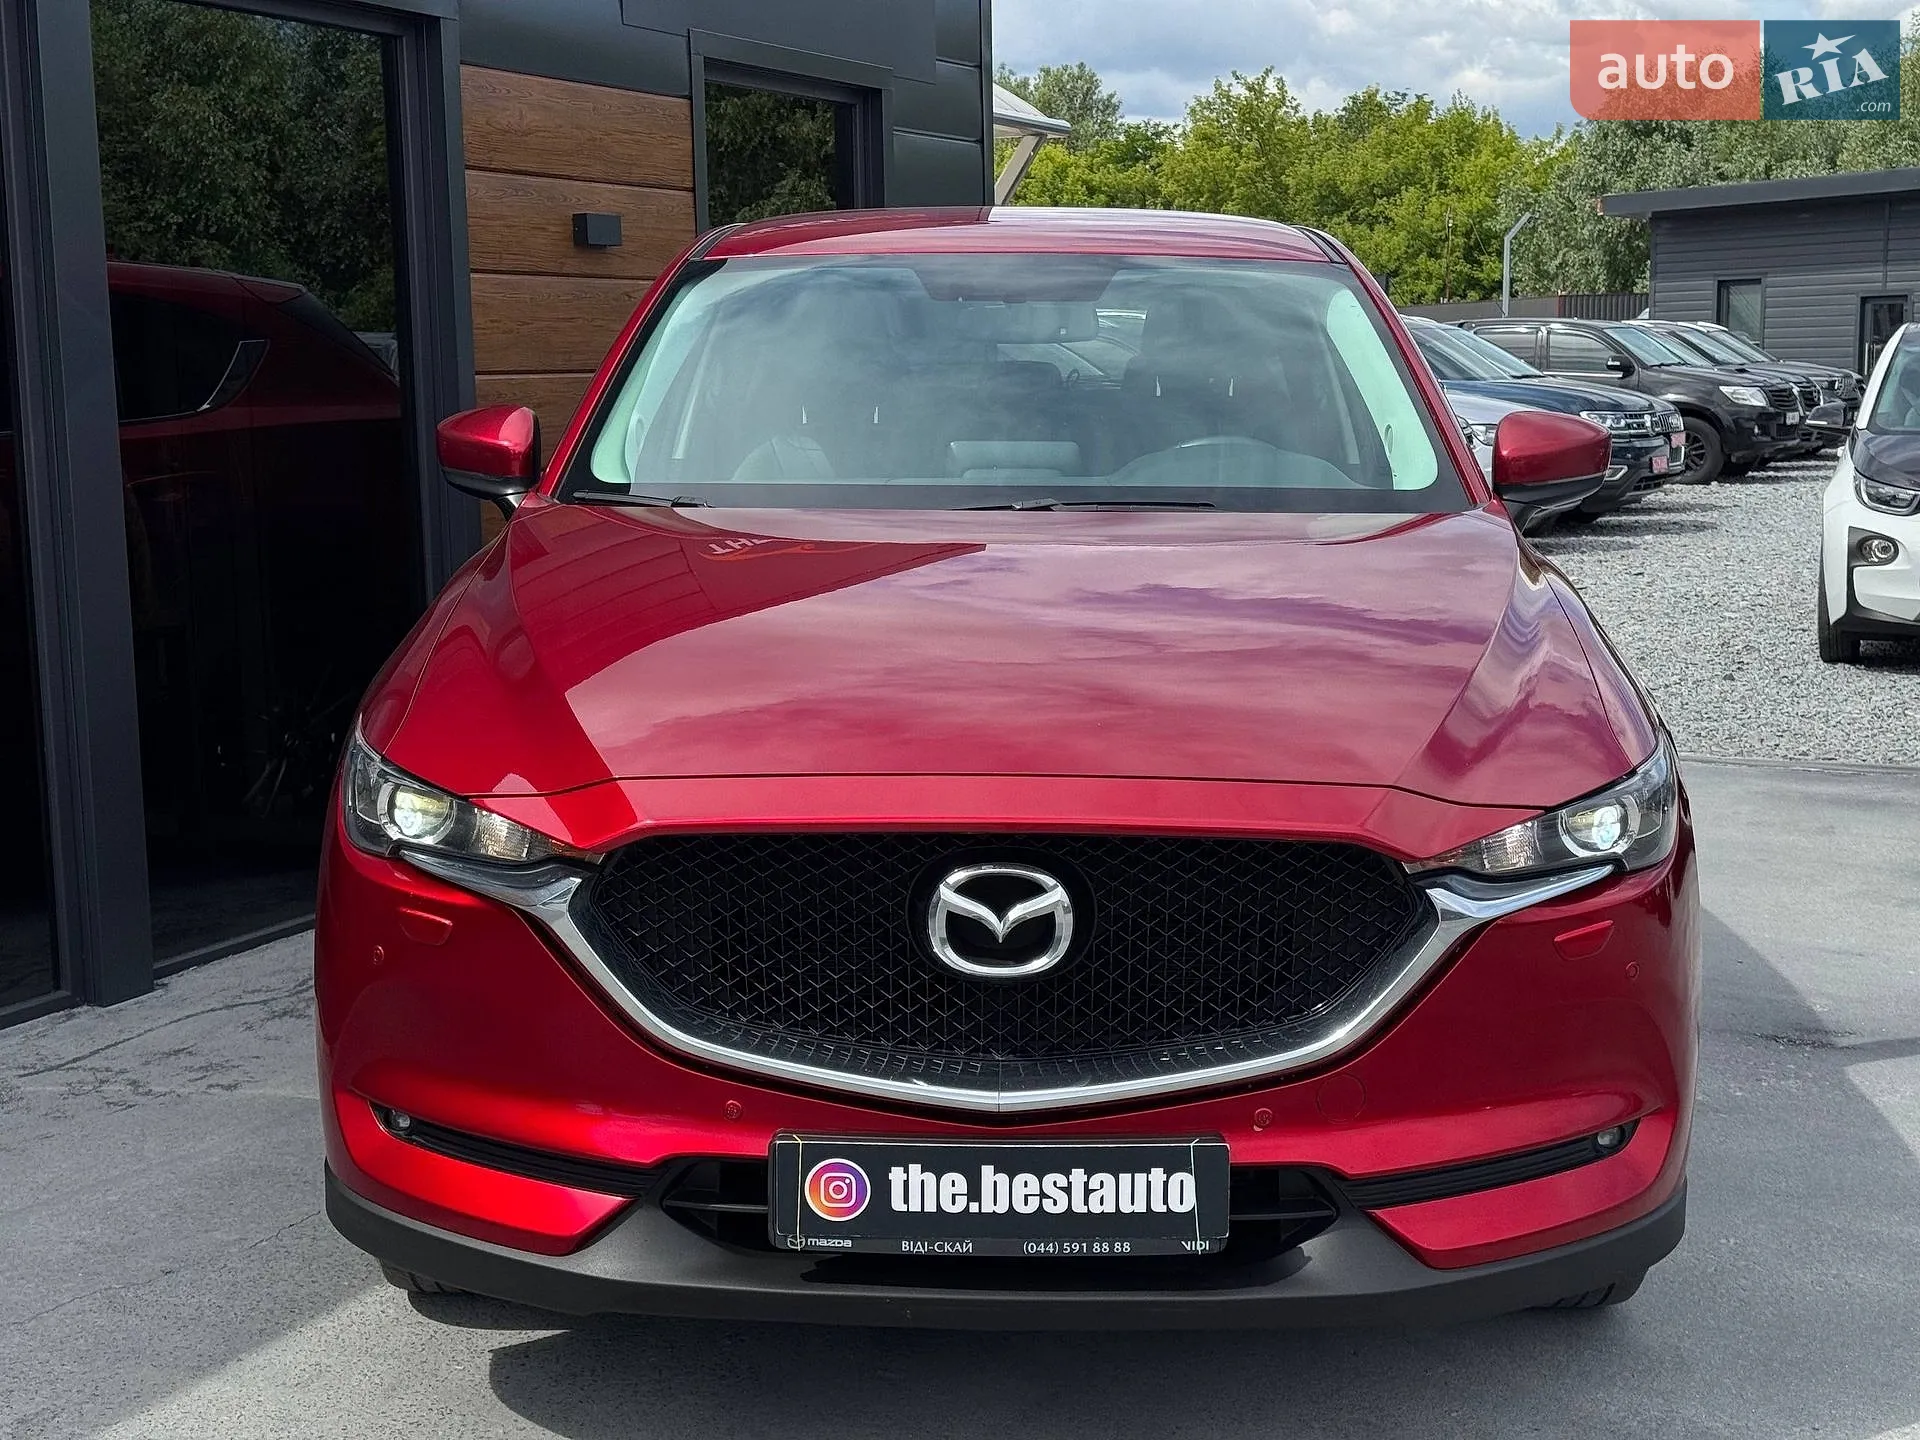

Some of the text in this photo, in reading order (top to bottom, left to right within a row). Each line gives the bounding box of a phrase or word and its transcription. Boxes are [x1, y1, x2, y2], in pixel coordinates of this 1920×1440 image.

[888, 1163, 1195, 1215] the.bestauto
[807, 1237, 852, 1248] mazda
[901, 1239, 1131, 1254] ВІДІ-СКАЙ (044) 591 88 88
[1181, 1240, 1209, 1251] VIDI
